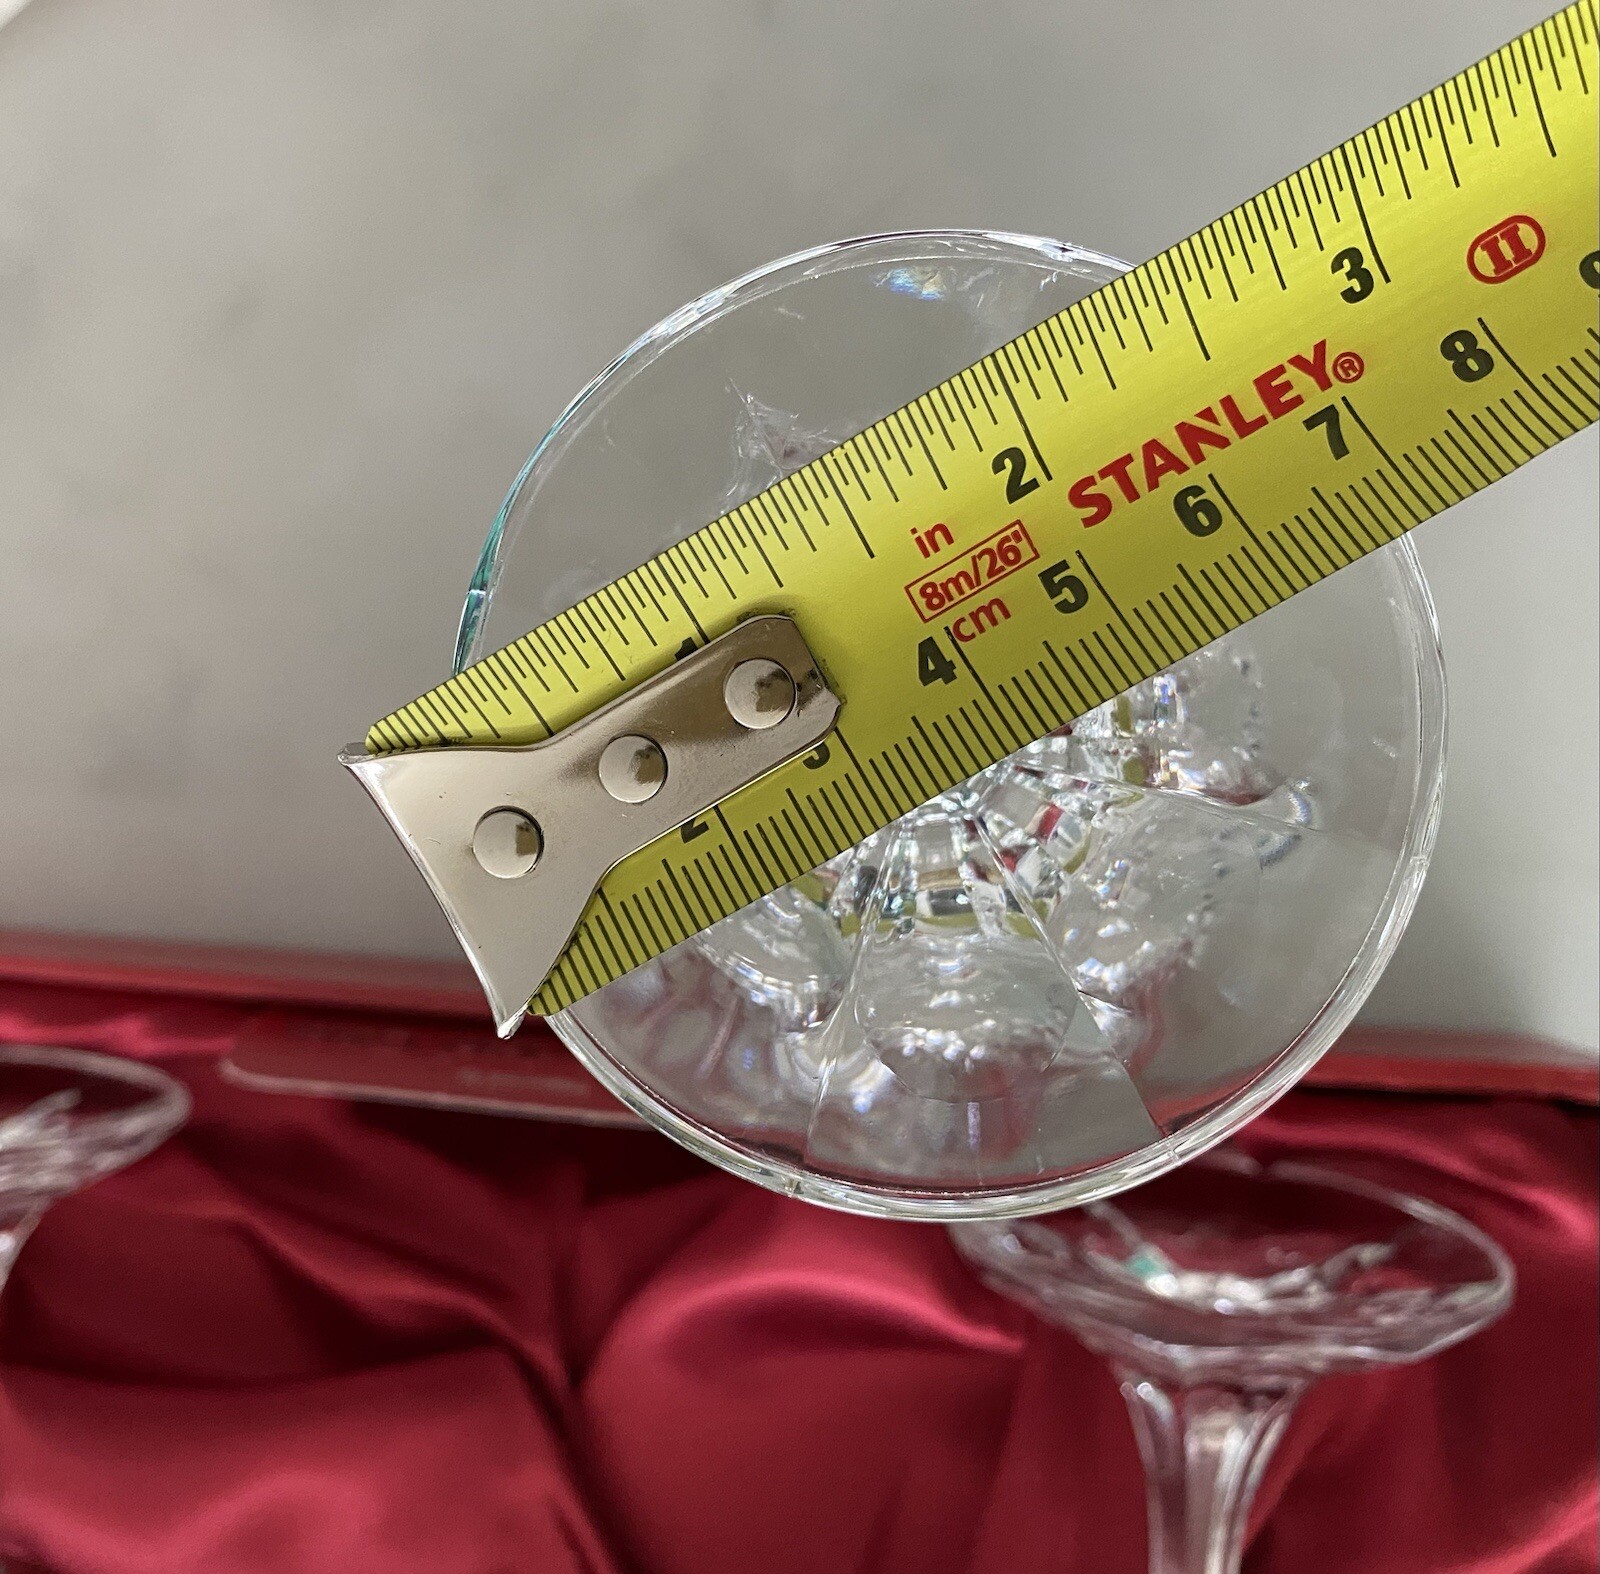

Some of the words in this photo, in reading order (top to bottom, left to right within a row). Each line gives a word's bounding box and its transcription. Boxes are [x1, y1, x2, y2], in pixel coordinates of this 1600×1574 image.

[1330, 246, 1375, 304] 3
[1440, 329, 1495, 383] 8
[1302, 403, 1350, 461] 7
[990, 446, 1040, 505] 2
[1172, 484, 1223, 538] 6
[910, 521, 954, 559] in
[1037, 559, 1089, 615] 5
[951, 597, 1011, 643] cm
[916, 635, 957, 687] 4
